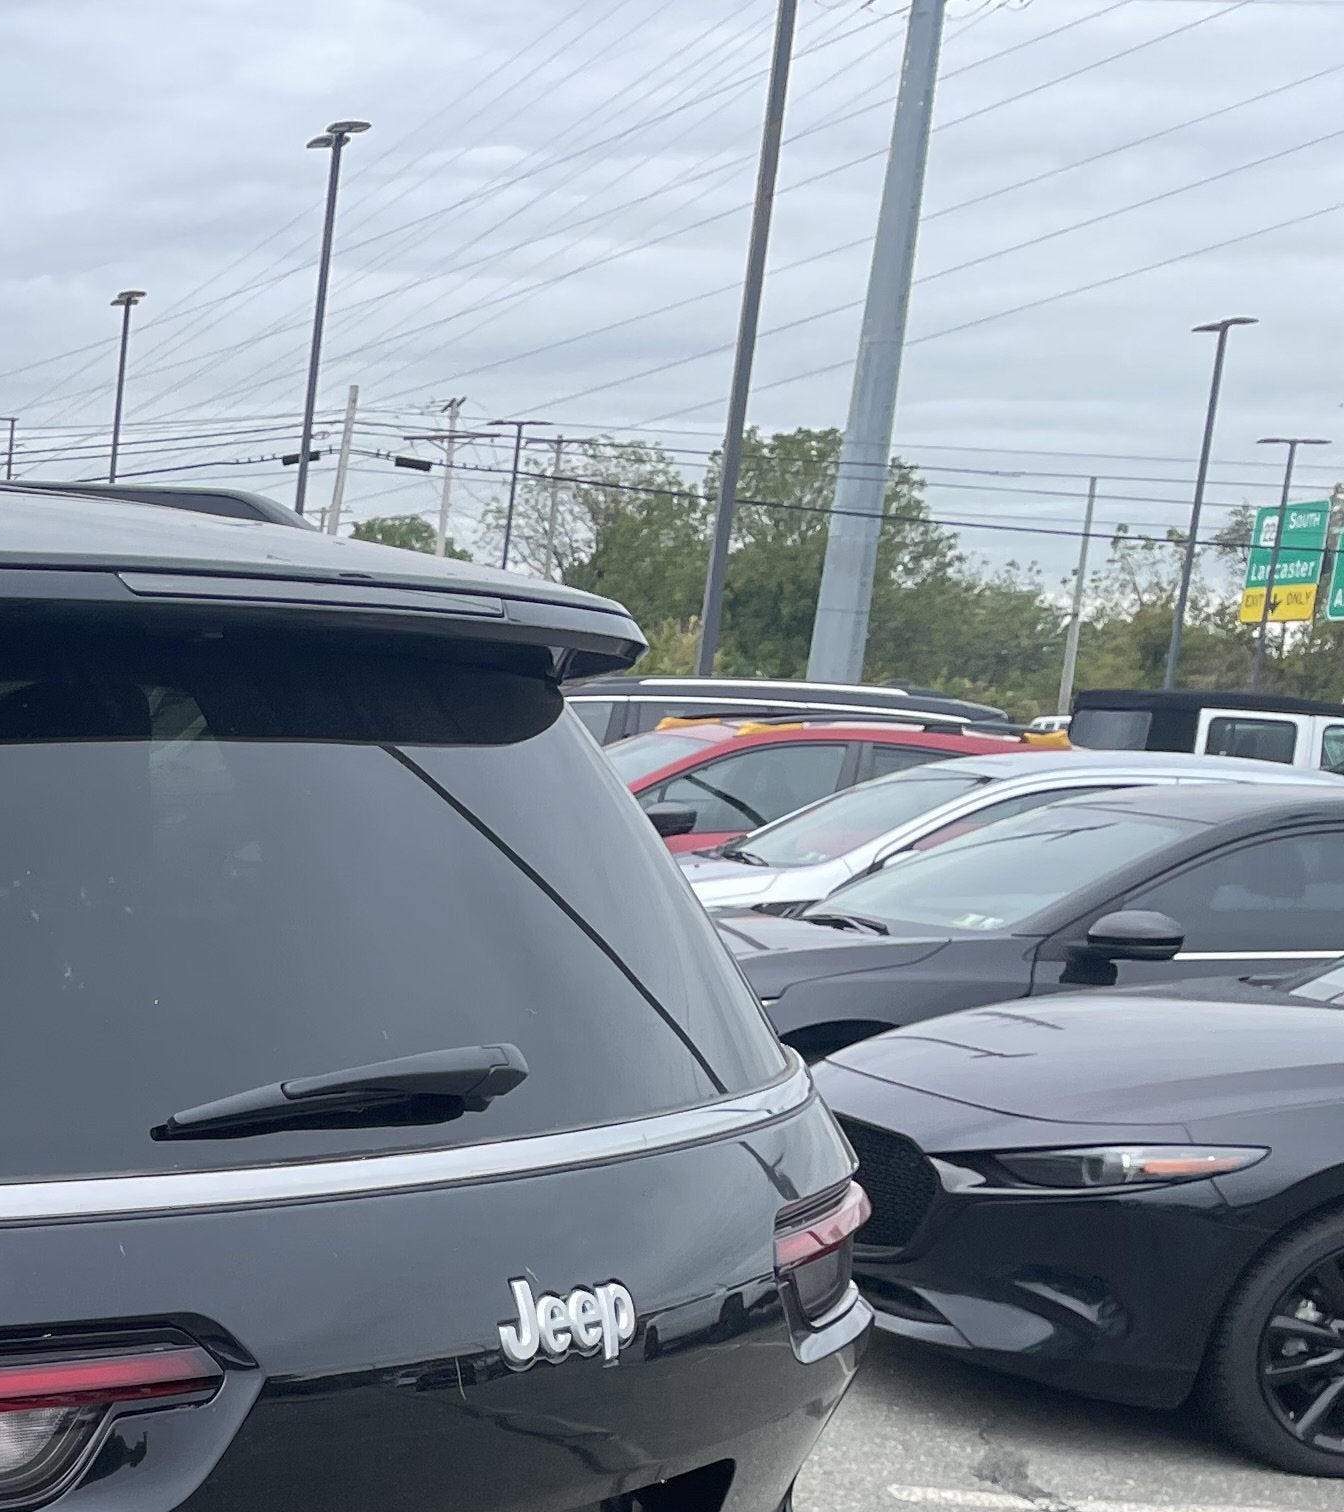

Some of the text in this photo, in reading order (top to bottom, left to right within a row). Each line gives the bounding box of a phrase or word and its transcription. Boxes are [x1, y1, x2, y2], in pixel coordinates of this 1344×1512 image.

[1244, 591, 1312, 608] EXIT ONLY
[498, 1277, 637, 1366] Jeep
